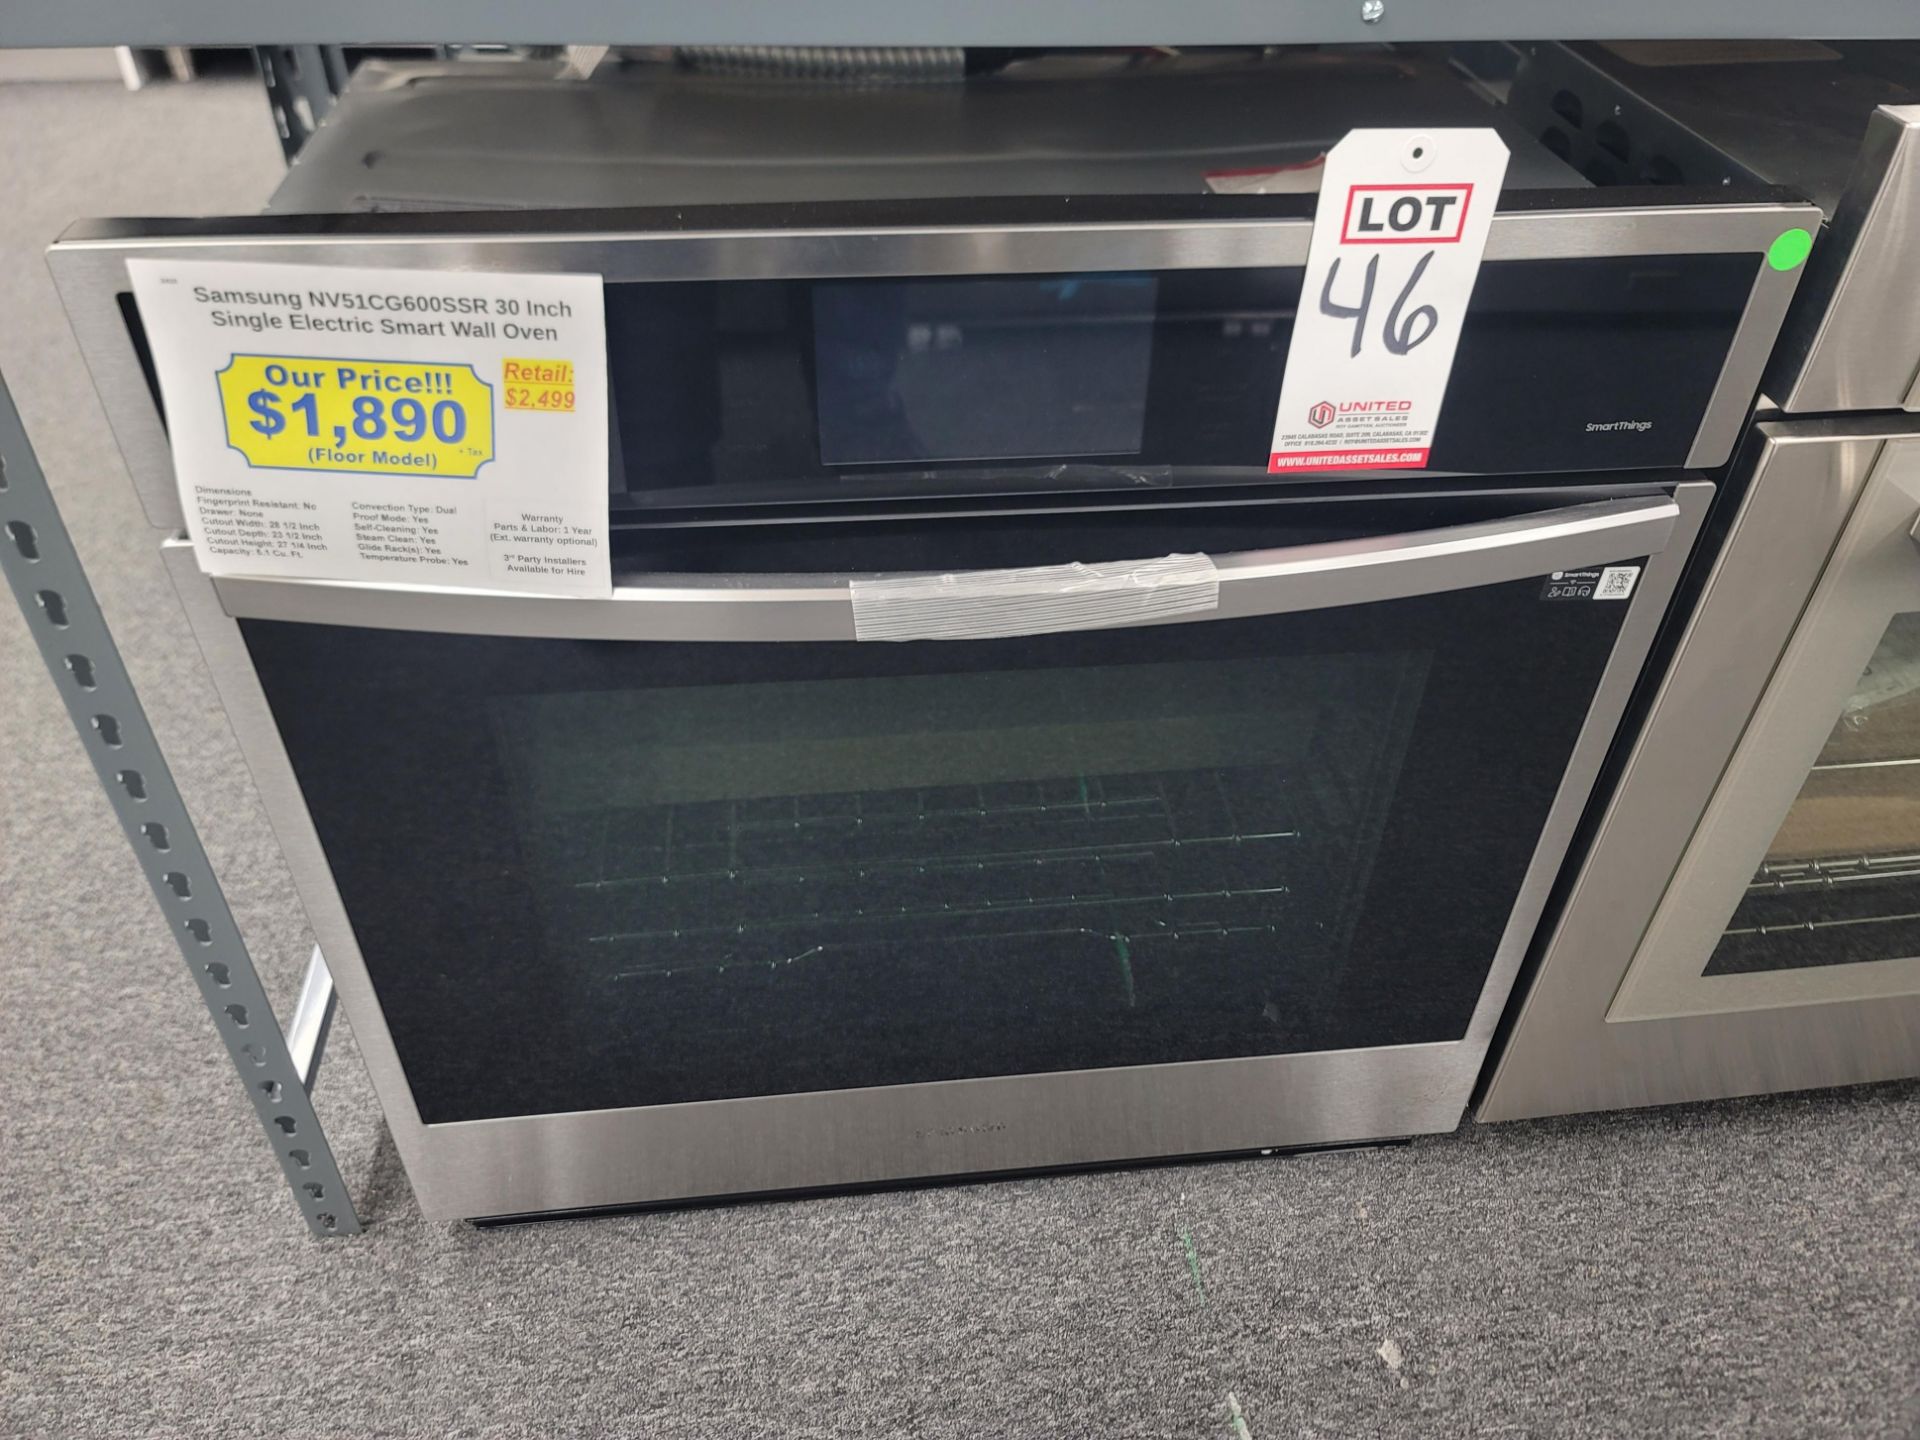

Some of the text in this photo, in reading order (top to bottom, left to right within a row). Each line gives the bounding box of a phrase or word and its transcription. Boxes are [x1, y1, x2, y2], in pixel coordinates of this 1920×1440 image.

[1358, 196, 1457, 232] LOT
[193, 286, 572, 317] Samsung NV51CG600SSR 30 Inch
[1319, 250, 1438, 359] 46
[211, 310, 558, 341] Single Electric Smart Wall Oven
[264, 364, 453, 395] Our Price!!!
[503, 362, 574, 383] Retail:
[1339, 401, 1412, 412] UNITED
[247, 388, 466, 449] $1,890
[1585, 420, 1652, 432] SmartThings
[307, 447, 438, 470] (Floor Model)
[1277, 452, 1423, 467] WWW.UNITEDASSETSALES.COM
[195, 486, 252, 496] Dimensions
[197, 496, 250, 507] Fingerprint
[303, 502, 317, 511] No
[352, 502, 457, 514] Convection Type: Dual
[239, 510, 264, 518] None
[353, 512, 429, 524] Proof Mode: Yes
[521, 513, 564, 524] Warranty
[201, 517, 234, 526] Cutout
[300, 522, 320, 531] Inch
[422, 526, 439, 535] Yes
[494, 522, 518, 531] Parts
[521, 524, 528, 532] &
[531, 525, 561, 534] Labor:
[571, 526, 592, 535] Year
[204, 527, 236, 536] Cutout
[302, 532, 323, 541] Inch
[356, 533, 436, 545] Steam Clean: Yes
[490, 533, 598, 548] (Ext. warranty optional)
[207, 537, 239, 546] Cutout
[307, 542, 328, 552] Inch
[358, 543, 382, 552] Glide
[425, 546, 441, 555] Yes
[360, 552, 469, 566] Temperature Probe: Yes
[517, 555, 541, 564] Party
[544, 556, 587, 566] Installers
[507, 564, 586, 576] Available for Hire
